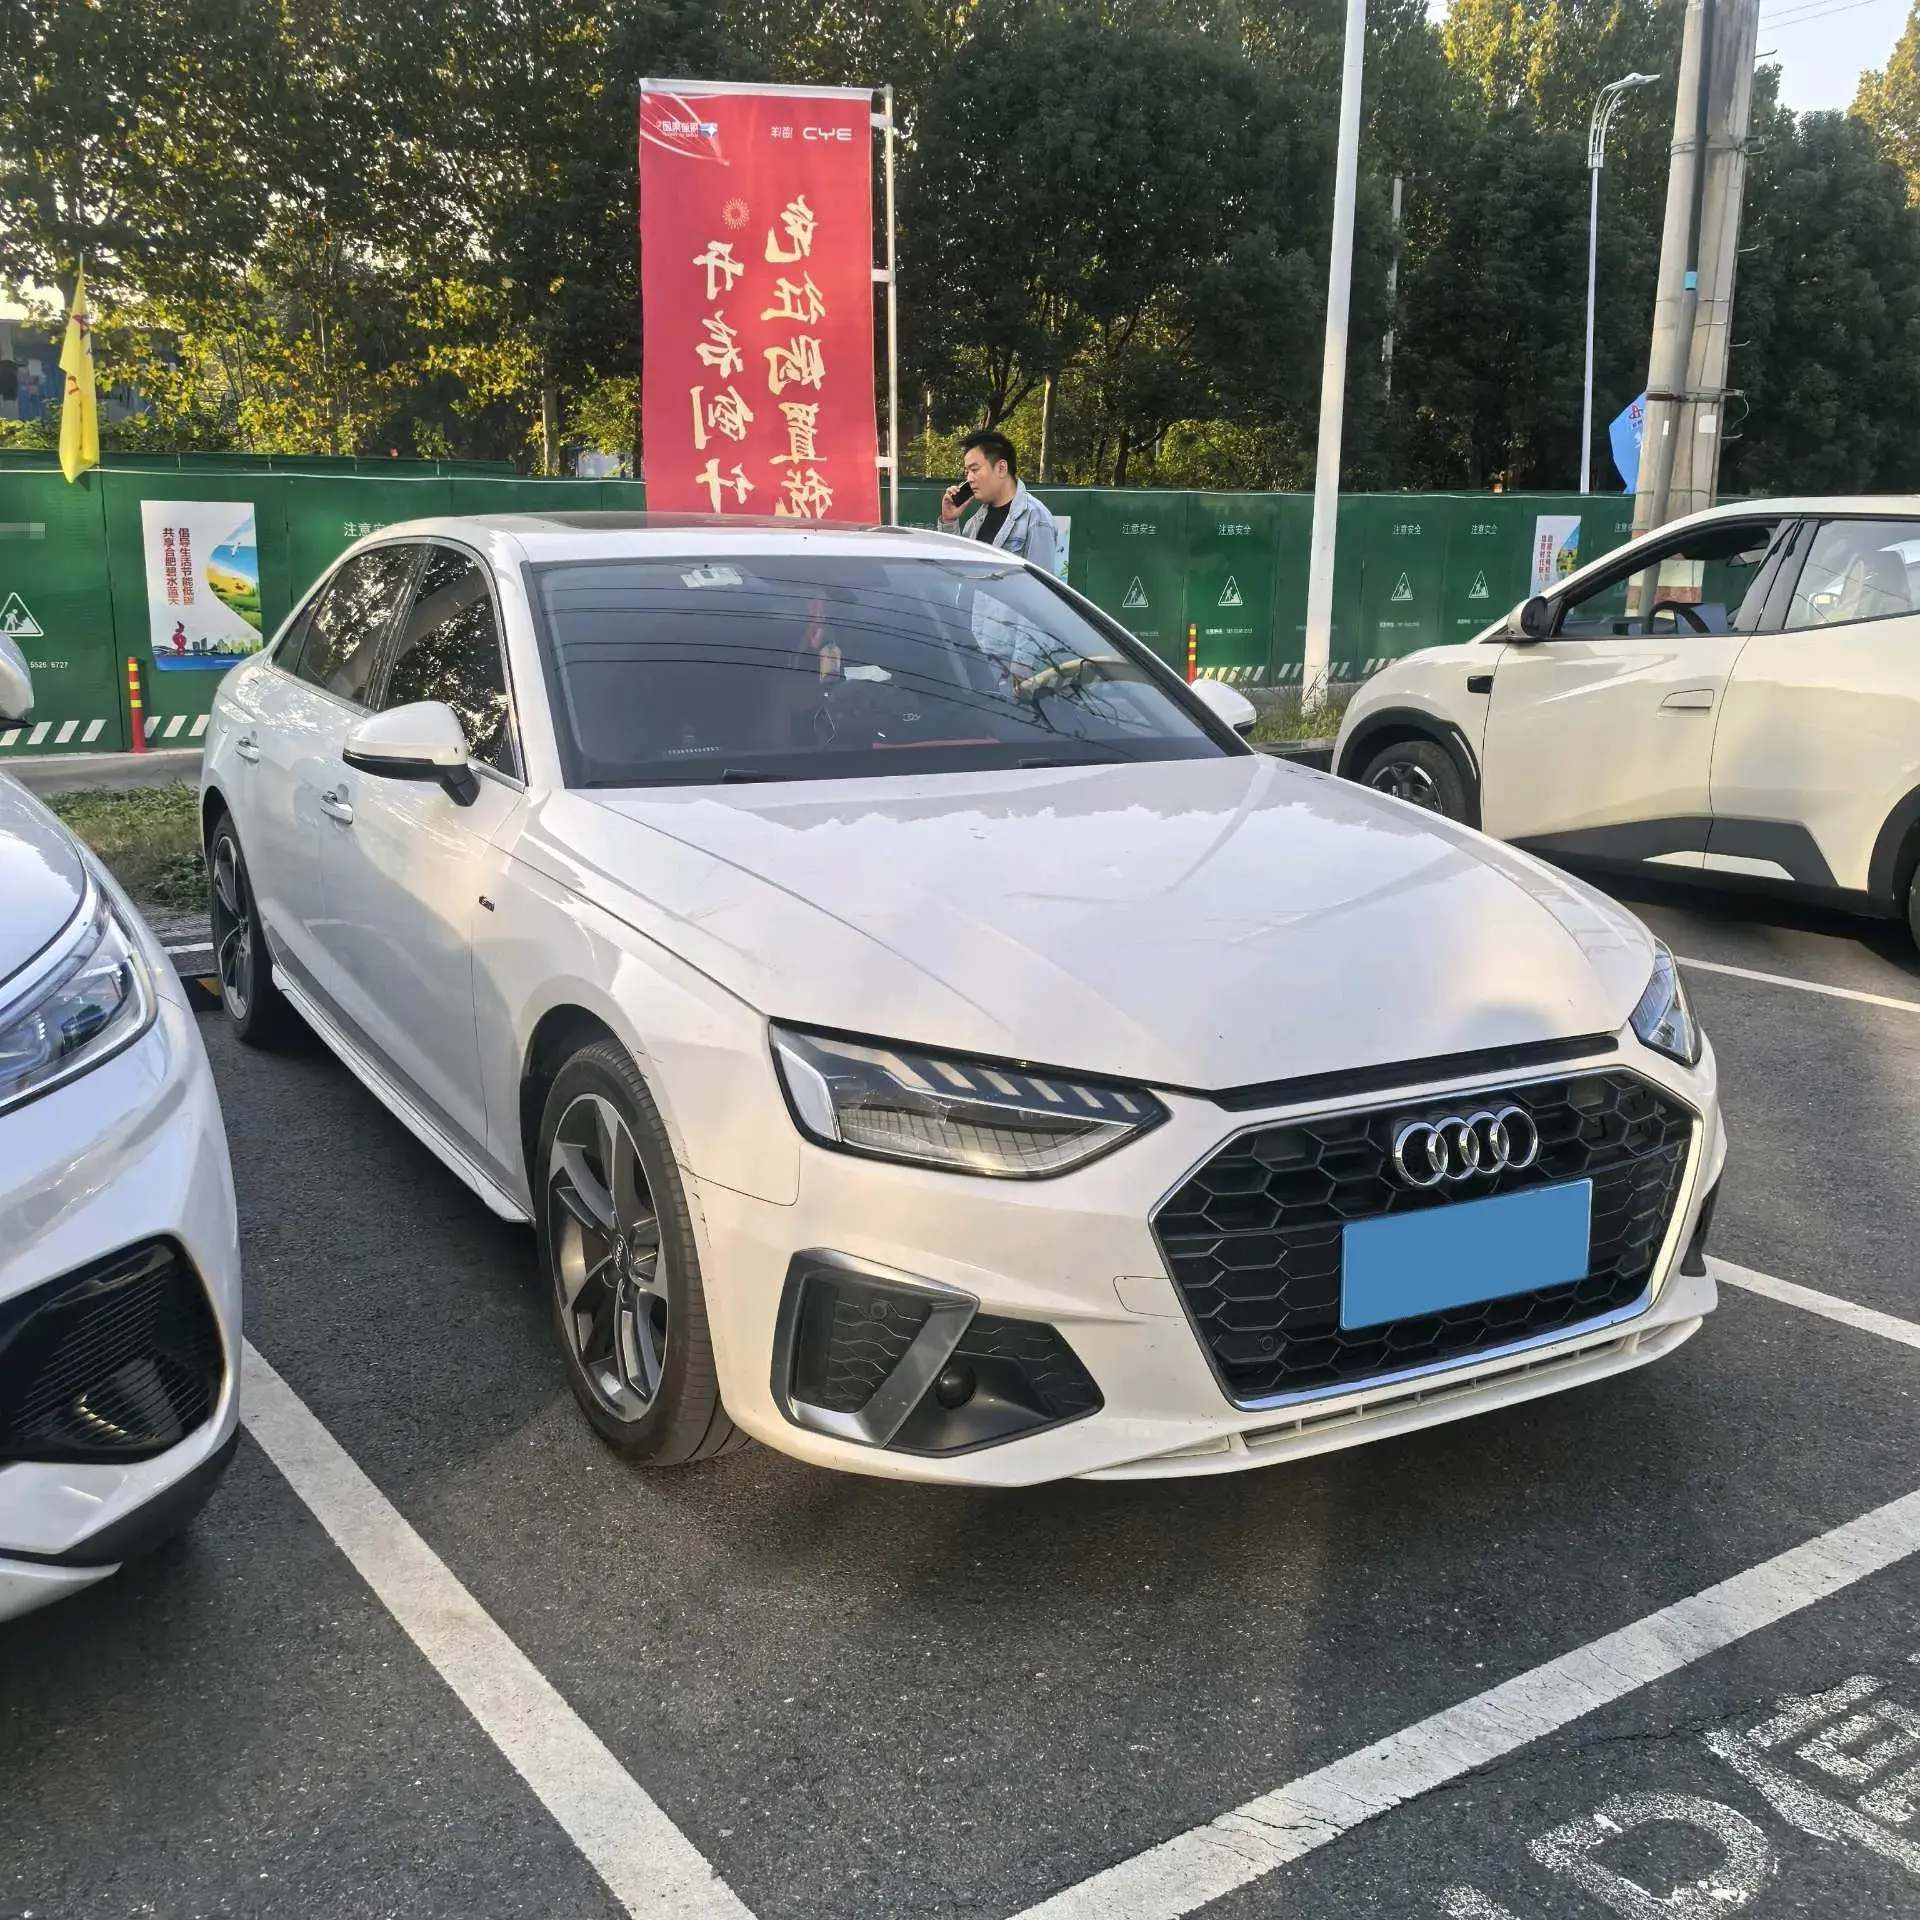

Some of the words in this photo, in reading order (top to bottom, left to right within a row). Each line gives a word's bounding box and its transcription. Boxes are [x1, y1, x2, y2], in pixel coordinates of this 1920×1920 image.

[1120, 522, 1157, 535] 注意安全
[1218, 523, 1252, 536] 注意安全
[1392, 523, 1422, 535] 注意安全
[1470, 523, 1498, 535] 注意安全
[162, 527, 180, 605] 共享合肥碧水蓝天
